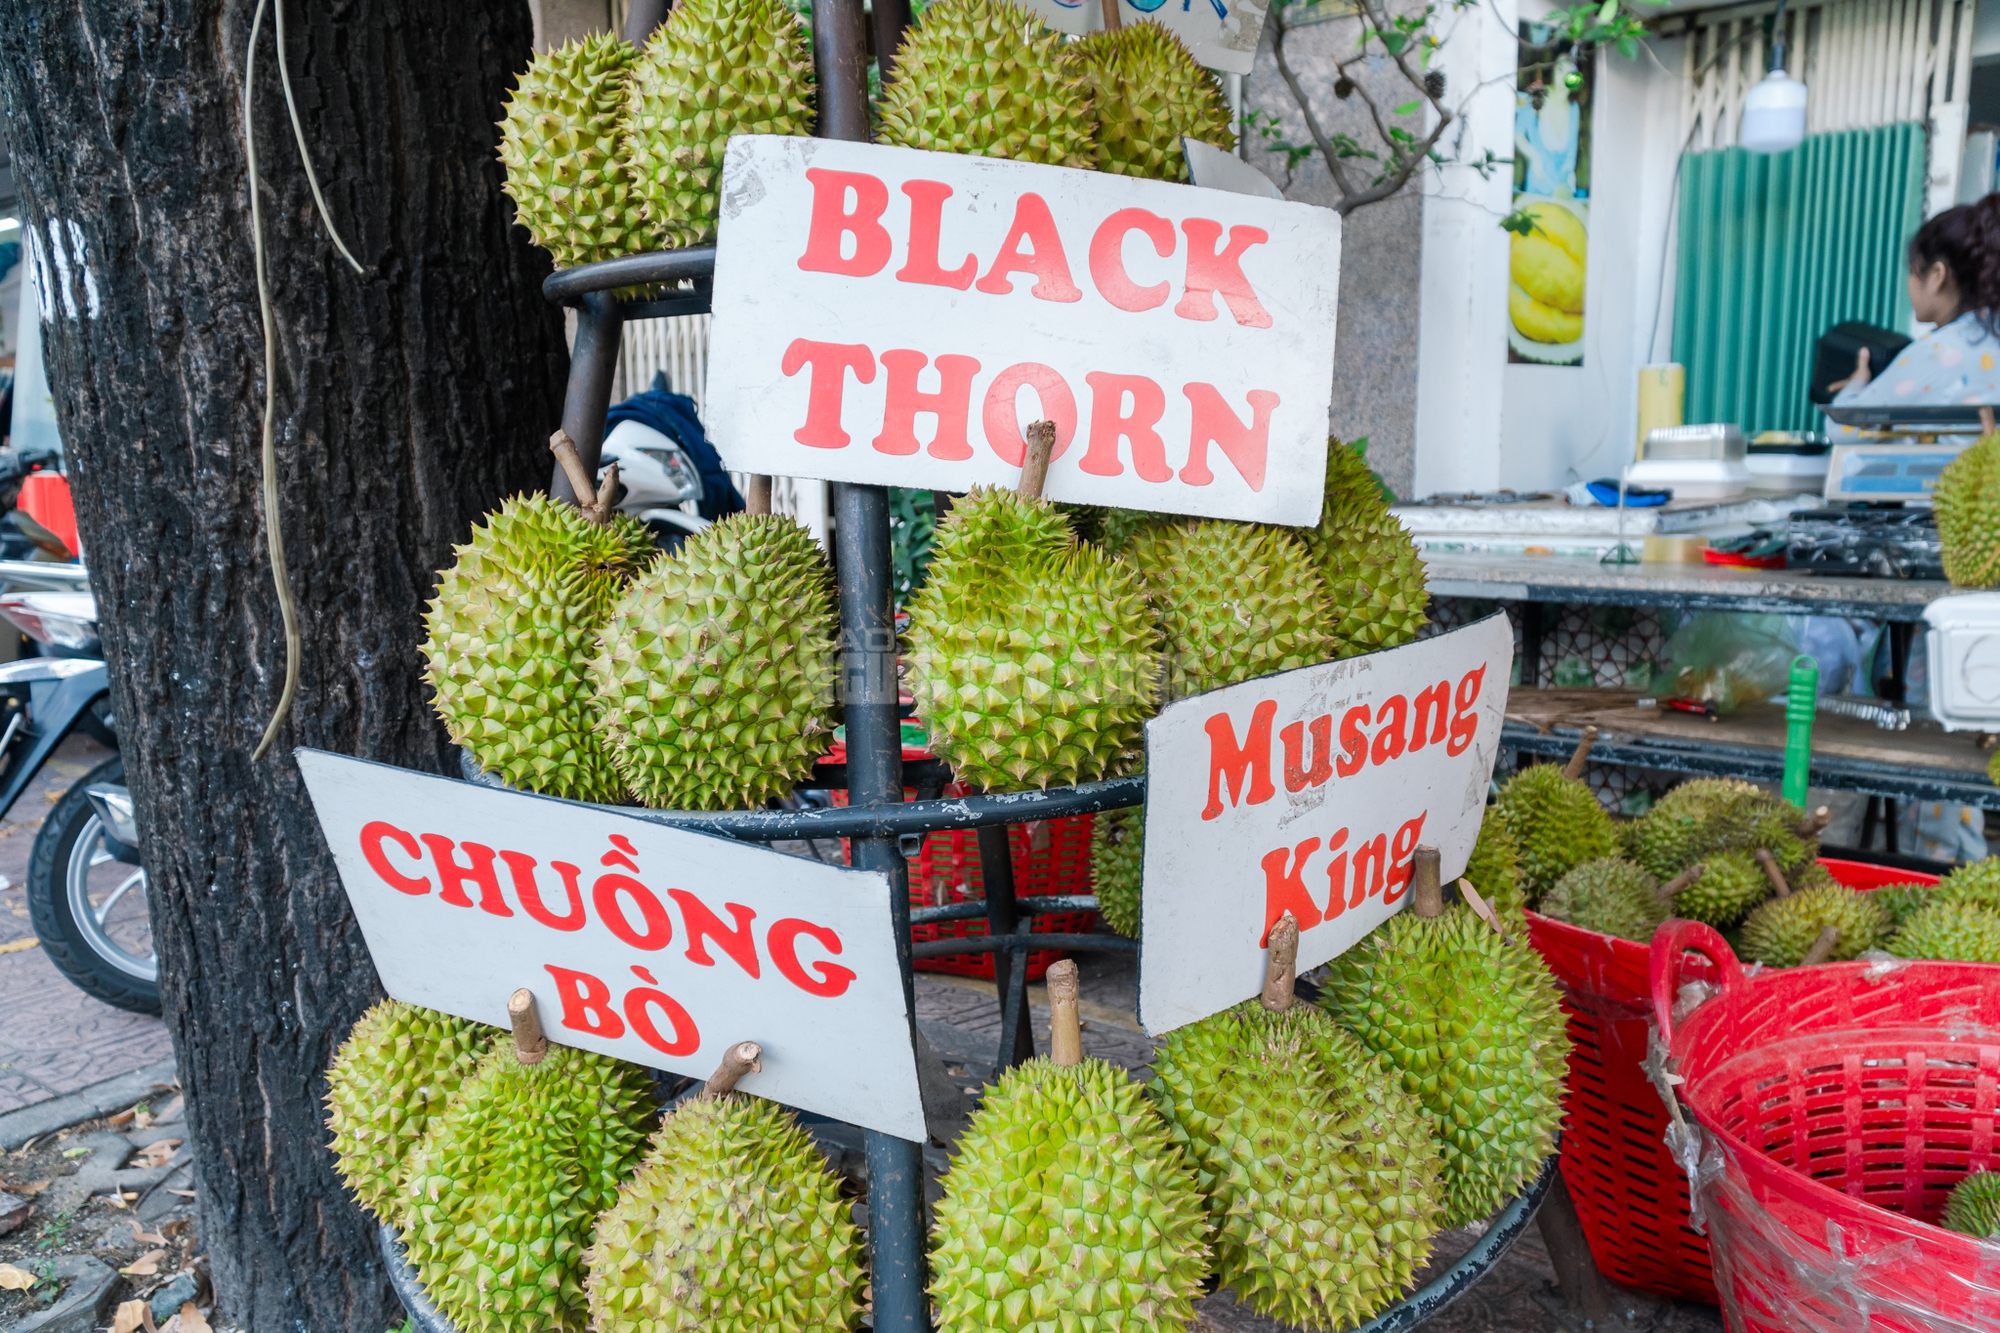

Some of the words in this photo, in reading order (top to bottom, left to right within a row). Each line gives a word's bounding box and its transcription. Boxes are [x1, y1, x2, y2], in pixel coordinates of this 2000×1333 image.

[797, 167, 1273, 329] BLACK
[781, 338, 1281, 492] THORN
[1201, 661, 1487, 821] Musang
[359, 820, 857, 998] CHUỒNG
[1259, 809, 1428, 949] King
[543, 964, 701, 1057] BÒ
